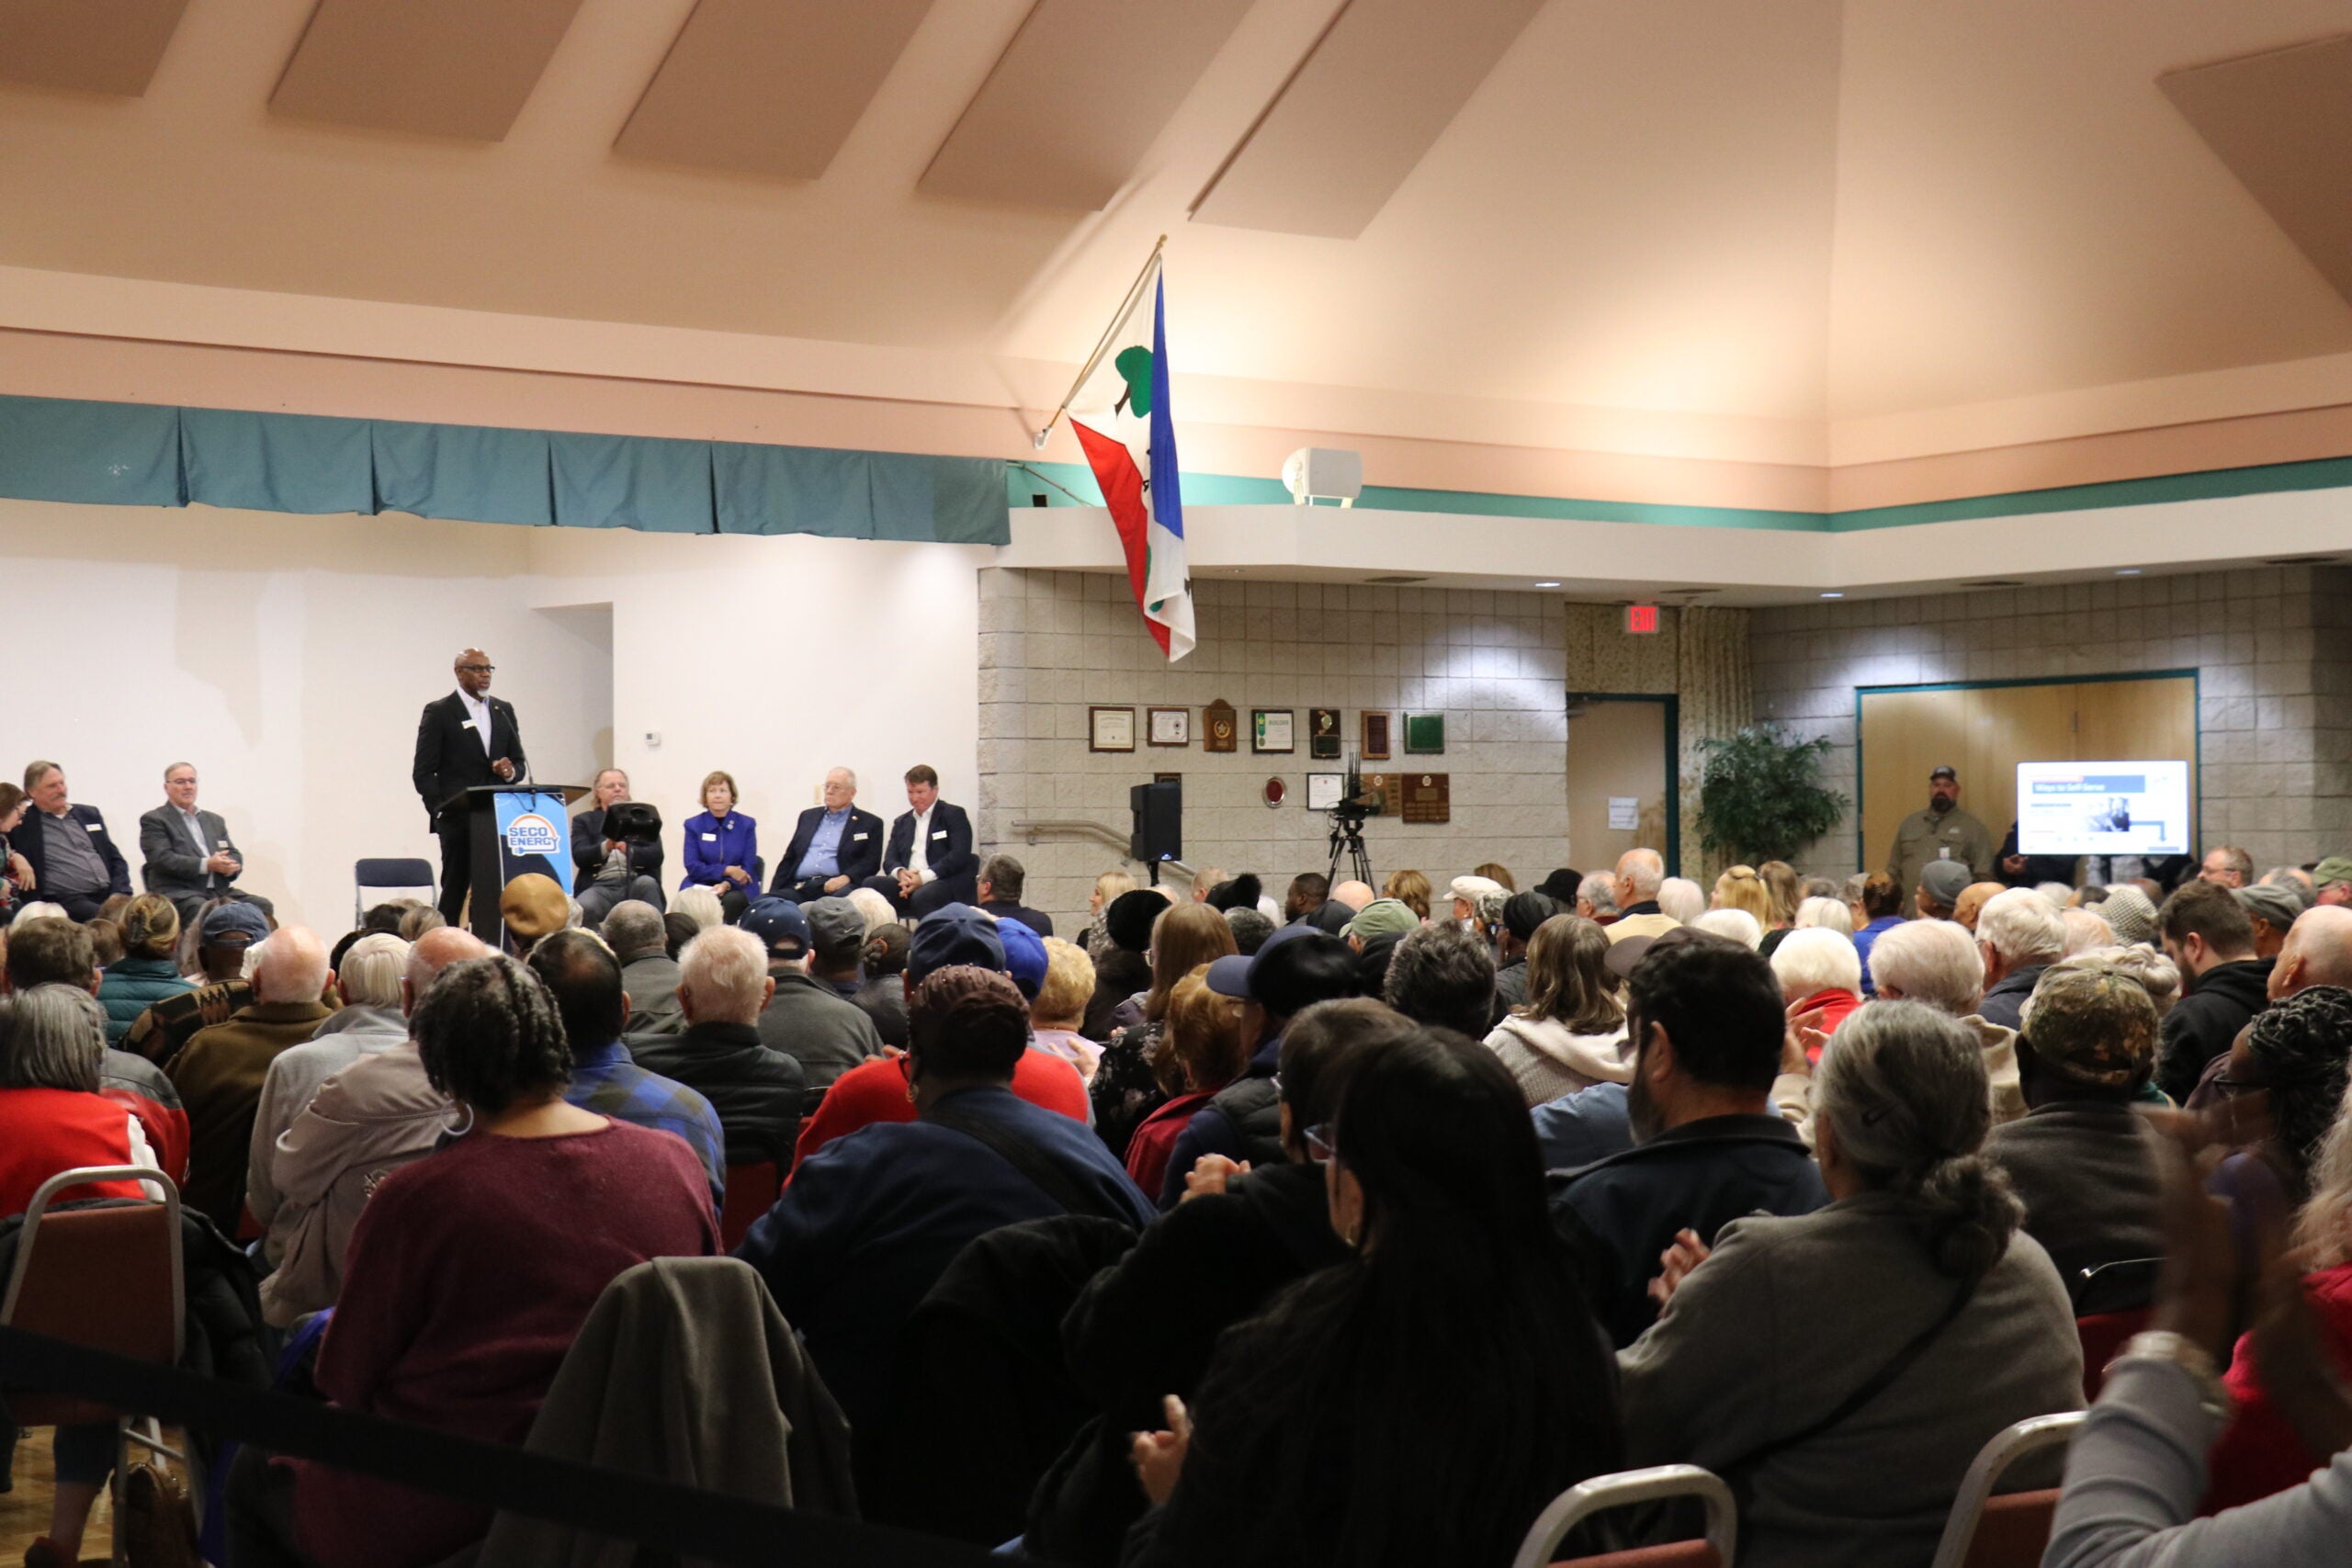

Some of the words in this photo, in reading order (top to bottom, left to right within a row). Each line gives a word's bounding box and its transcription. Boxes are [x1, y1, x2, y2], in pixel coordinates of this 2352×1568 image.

[1631, 606, 1656, 631] EXIT
[509, 827, 548, 837] SECO
[510, 837, 559, 846] ENERGY
